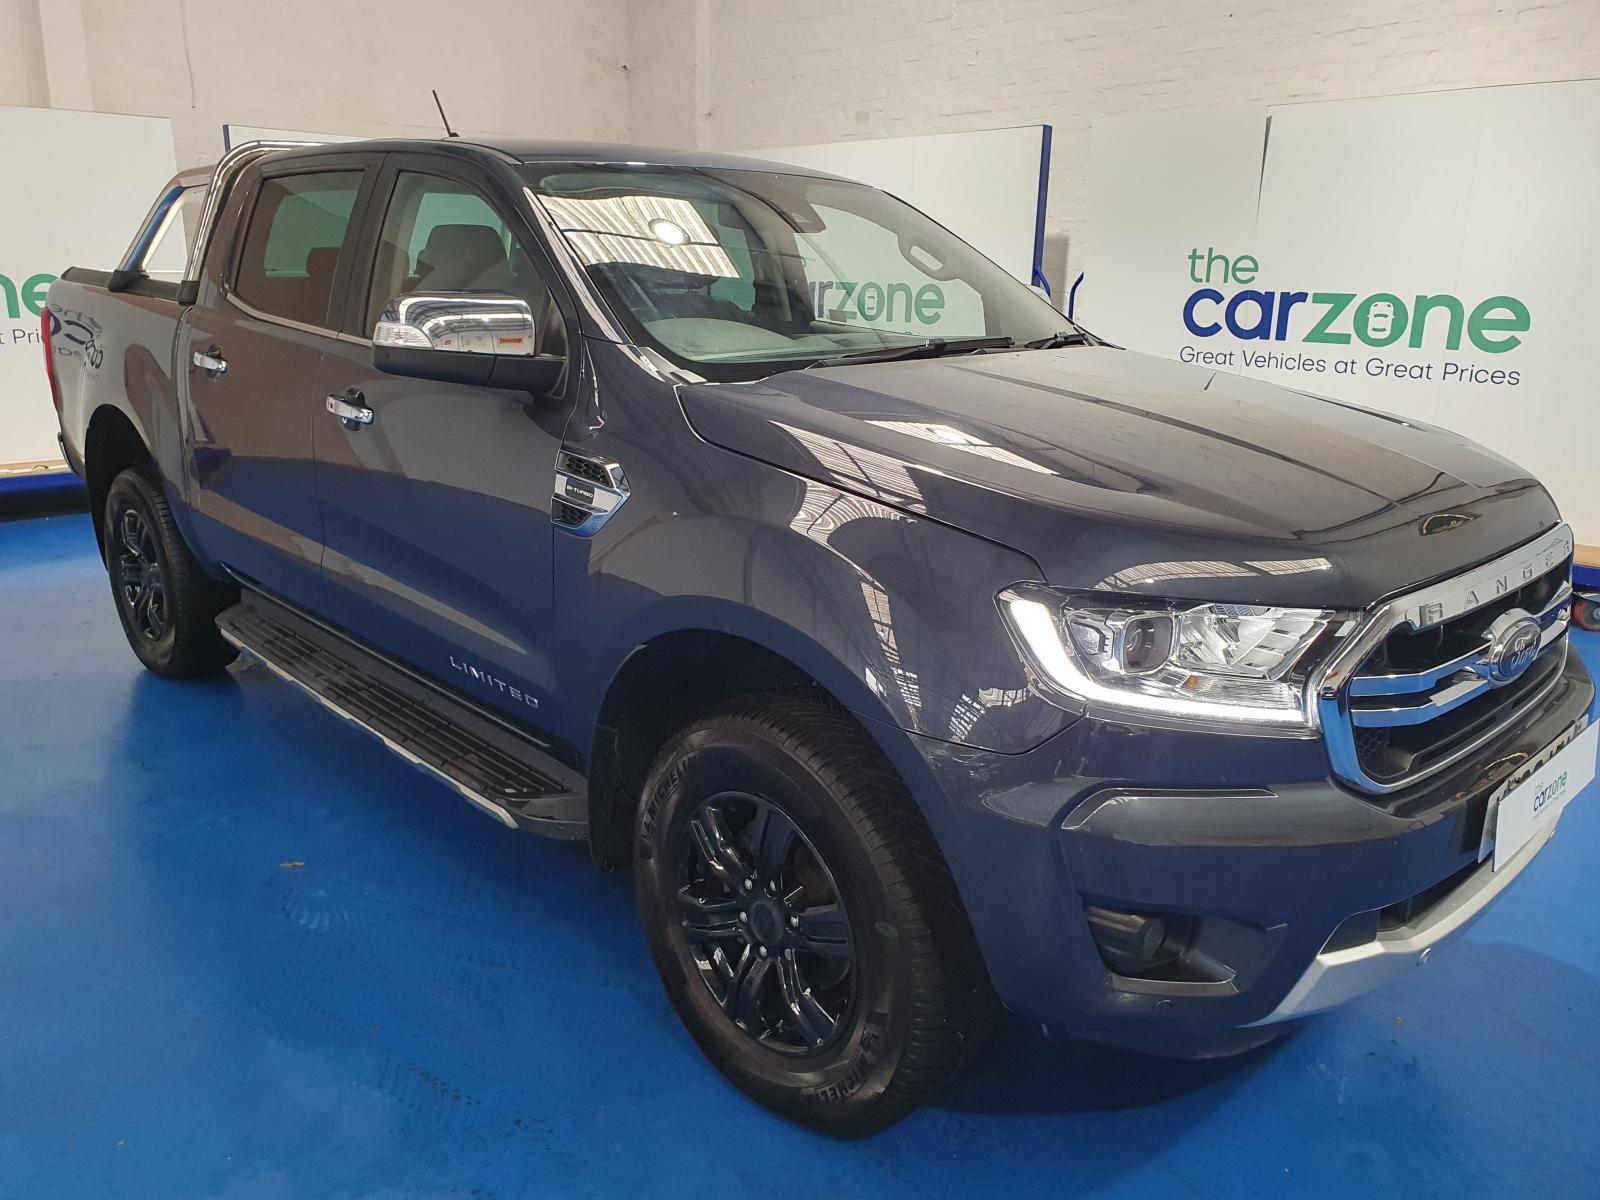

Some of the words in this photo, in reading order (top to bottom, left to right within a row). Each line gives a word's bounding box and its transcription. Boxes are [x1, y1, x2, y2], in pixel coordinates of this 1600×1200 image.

[1188, 247, 1259, 285] the
[1182, 288, 1531, 354] carzone
[1179, 345, 1235, 367] Great
[1242, 349, 1327, 373] Vehicles
[1334, 357, 1357, 375] at
[1365, 357, 1433, 381] Great
[1442, 362, 1521, 386] Prices
[449, 655, 539, 709] LIMITED
[1533, 770, 1568, 812] carzone
